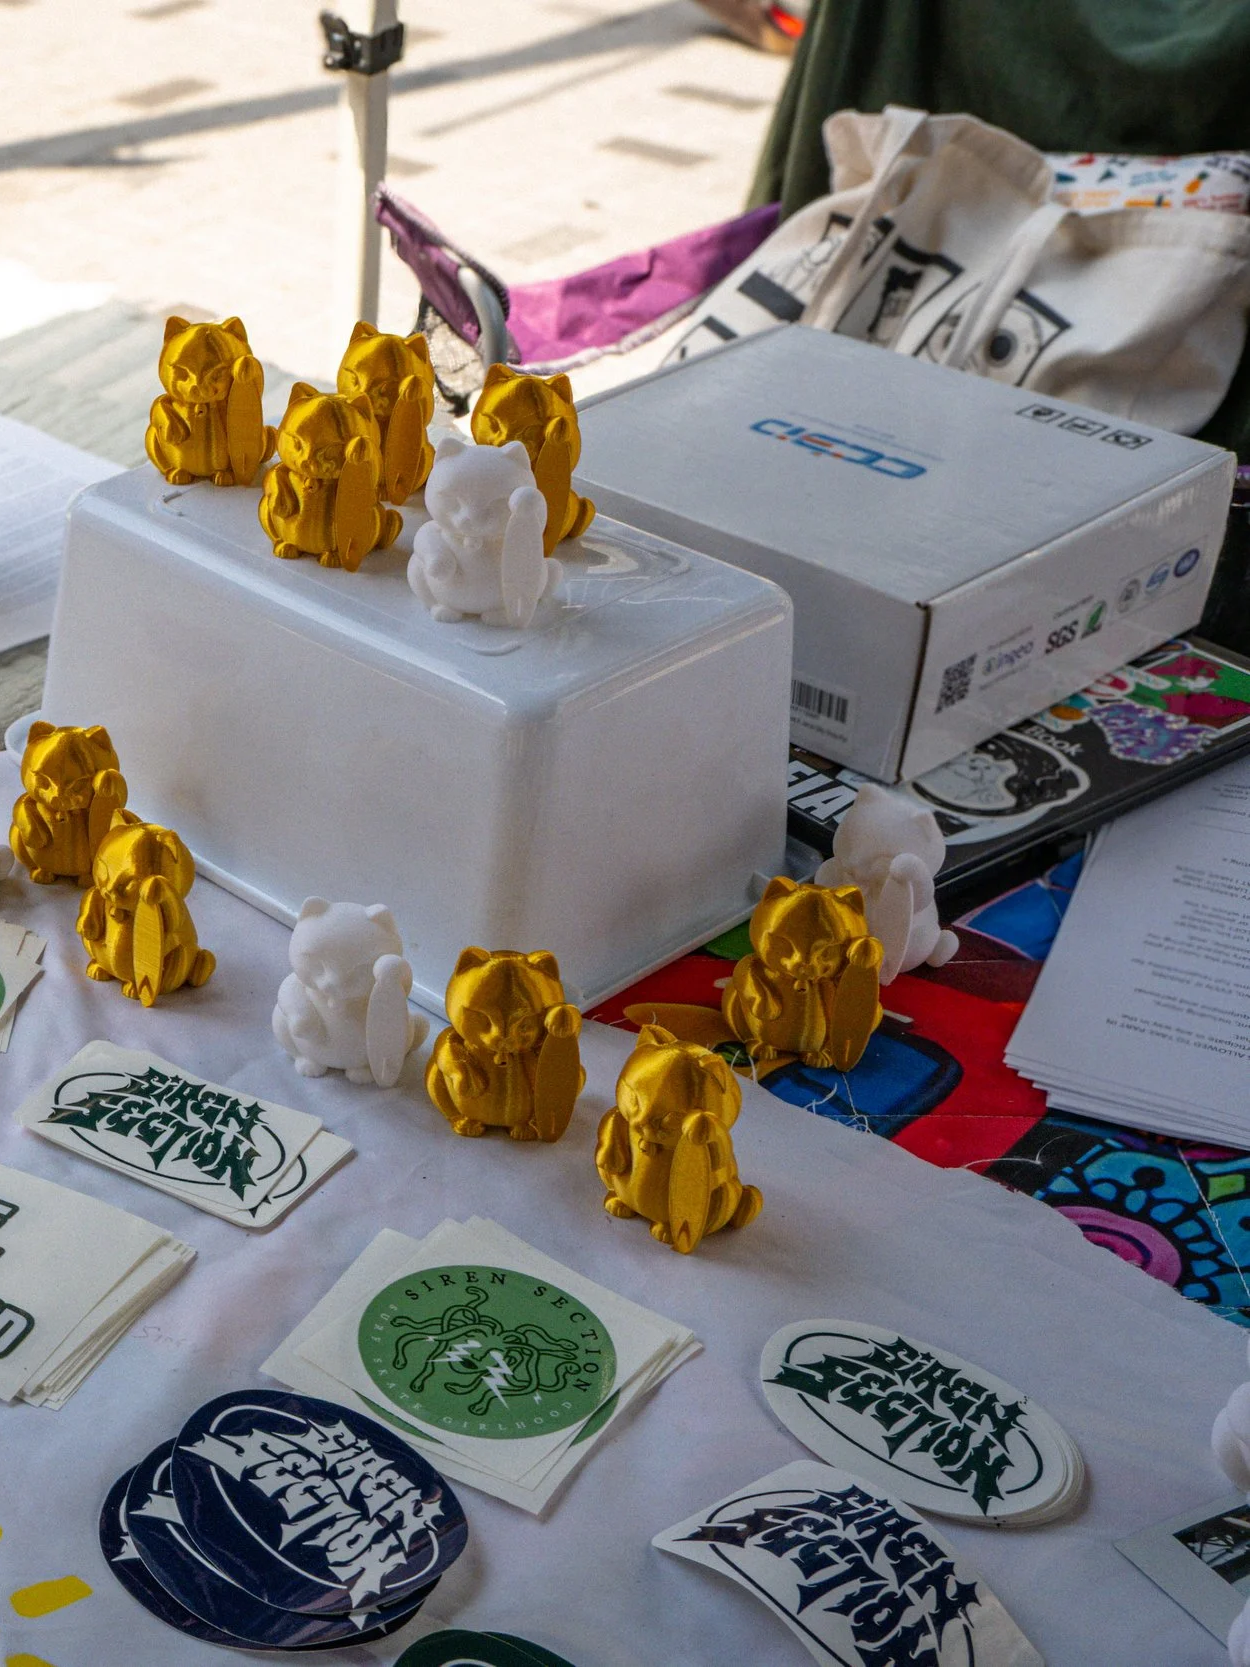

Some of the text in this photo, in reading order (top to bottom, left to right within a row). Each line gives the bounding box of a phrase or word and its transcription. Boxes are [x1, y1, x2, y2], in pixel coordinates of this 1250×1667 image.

[38, 1091, 262, 1202] SECTION
[404, 1271, 602, 1393] SIREN SECTION
[442, 1400, 573, 1431] GIRLHOOD
[763, 1353, 1015, 1517] SECTION
[177, 1427, 408, 1609] SECTION
